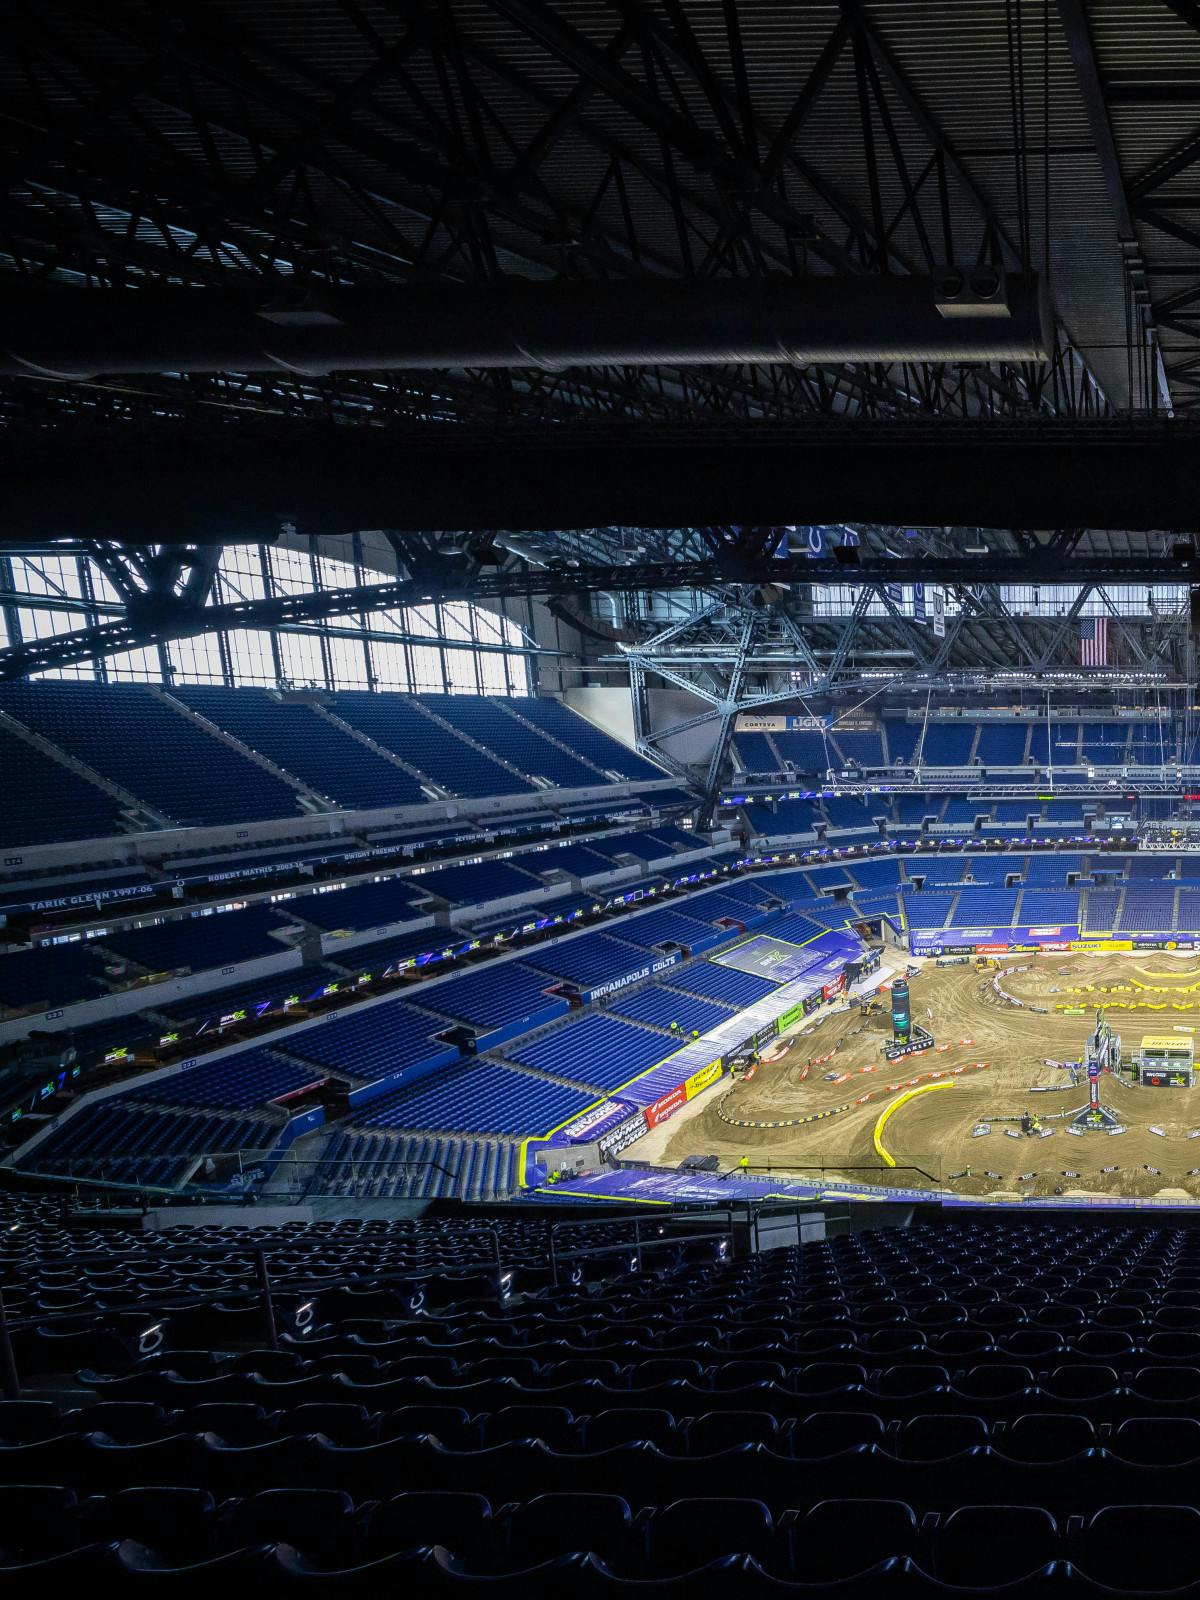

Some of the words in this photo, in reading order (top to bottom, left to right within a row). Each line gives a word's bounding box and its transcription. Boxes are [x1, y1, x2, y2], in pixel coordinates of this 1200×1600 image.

[792, 718, 827, 727] LIGHT
[344, 851, 370, 860] DWIGHT
[371, 847, 400, 856] FREENEY
[208, 870, 241, 882] ROBERT
[242, 867, 273, 876] MATHIS
[276, 862, 304, 871] 2003-16
[31, 899, 66, 911] TARIK
[70, 893, 110, 904] GLENN
[113, 885, 153, 898] 1997-06
[590, 967, 650, 1000] INDIANAPOLIS
[652, 955, 676, 972] COLTS
[900, 1040, 933, 1054] OAKLEY
[657, 1089, 682, 1107] HONDA
[659, 1099, 683, 1118] HONDA
